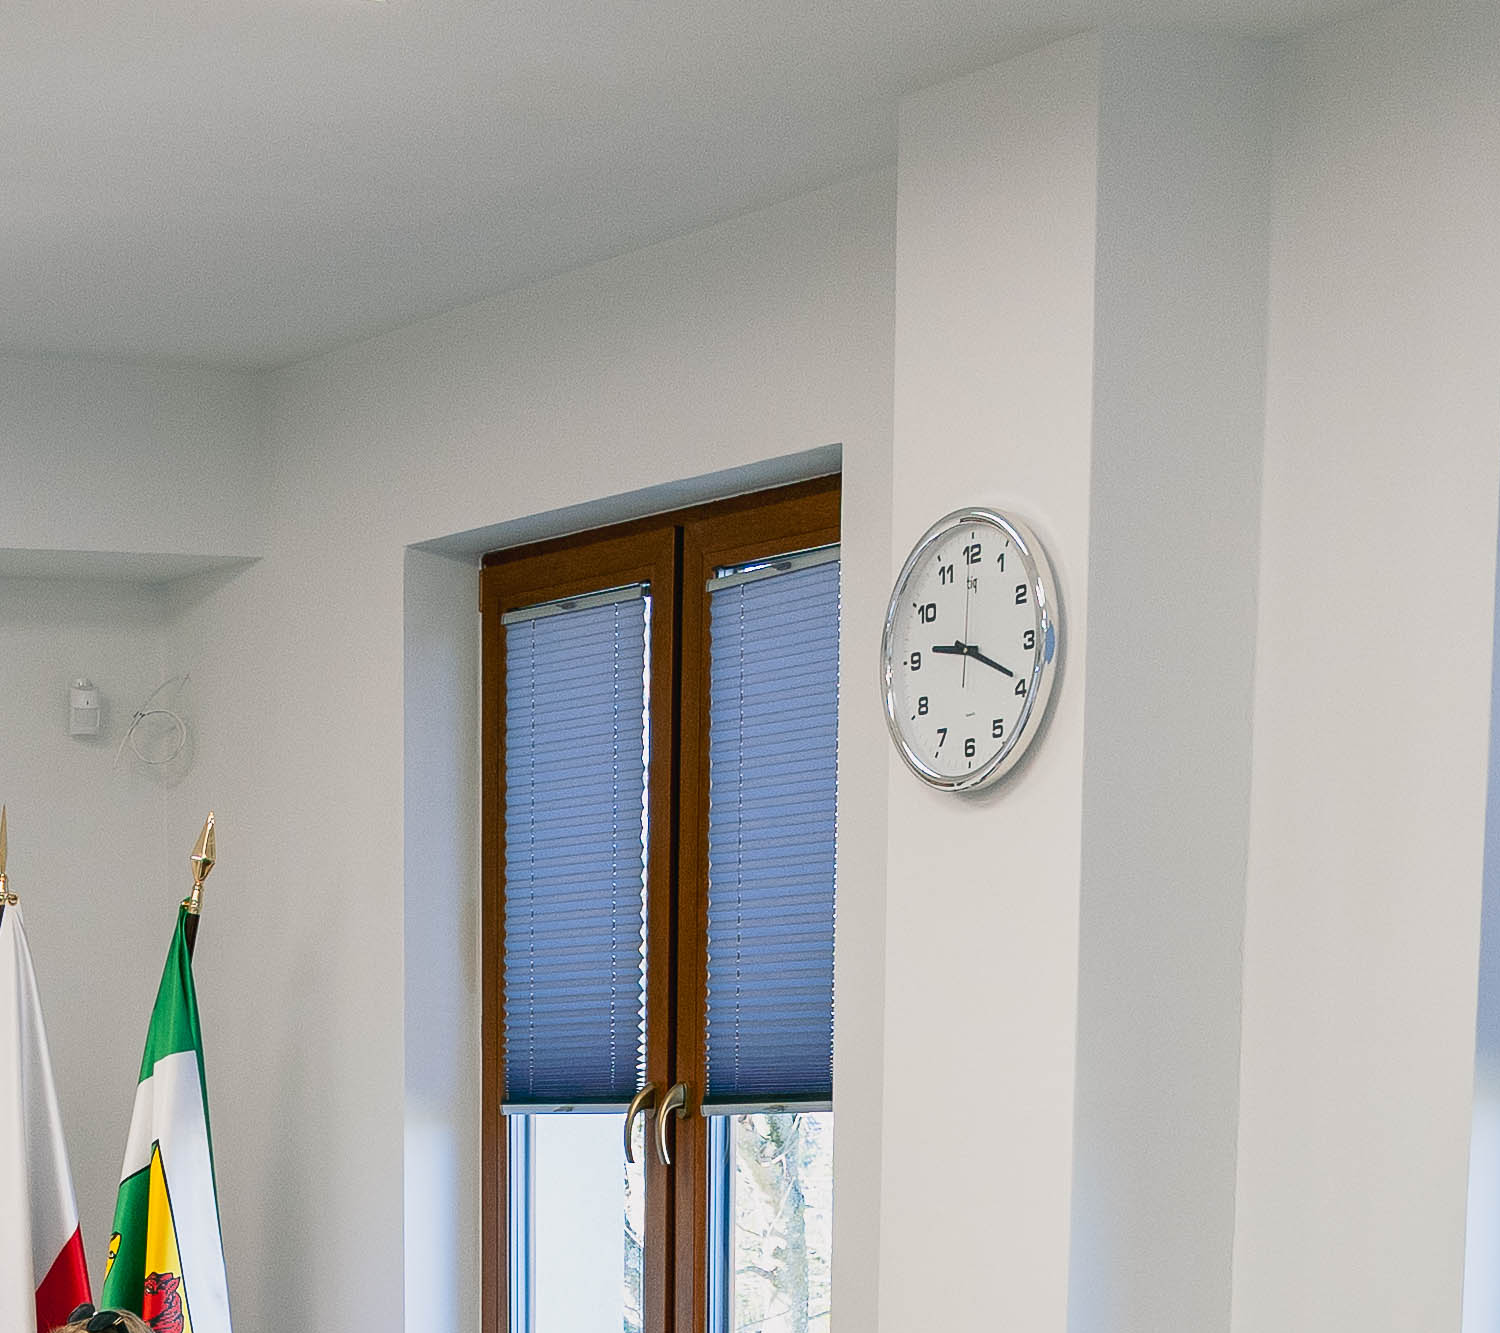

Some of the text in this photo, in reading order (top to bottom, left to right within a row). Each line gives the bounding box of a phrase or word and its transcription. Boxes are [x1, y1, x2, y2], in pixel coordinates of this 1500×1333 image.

[962, 543, 982, 565] 12
[997, 553, 1005, 573] 1
[939, 564, 954, 586] 11
[1015, 584, 1027, 605] 2
[918, 602, 937, 624] 10
[1023, 629, 1035, 650] 3
[910, 651, 922, 671] 9
[1014, 678, 1027, 698] 4
[917, 696, 929, 716] 8
[937, 728, 948, 748] 7
[992, 718, 1004, 739] 5
[964, 737, 975, 758] 6
